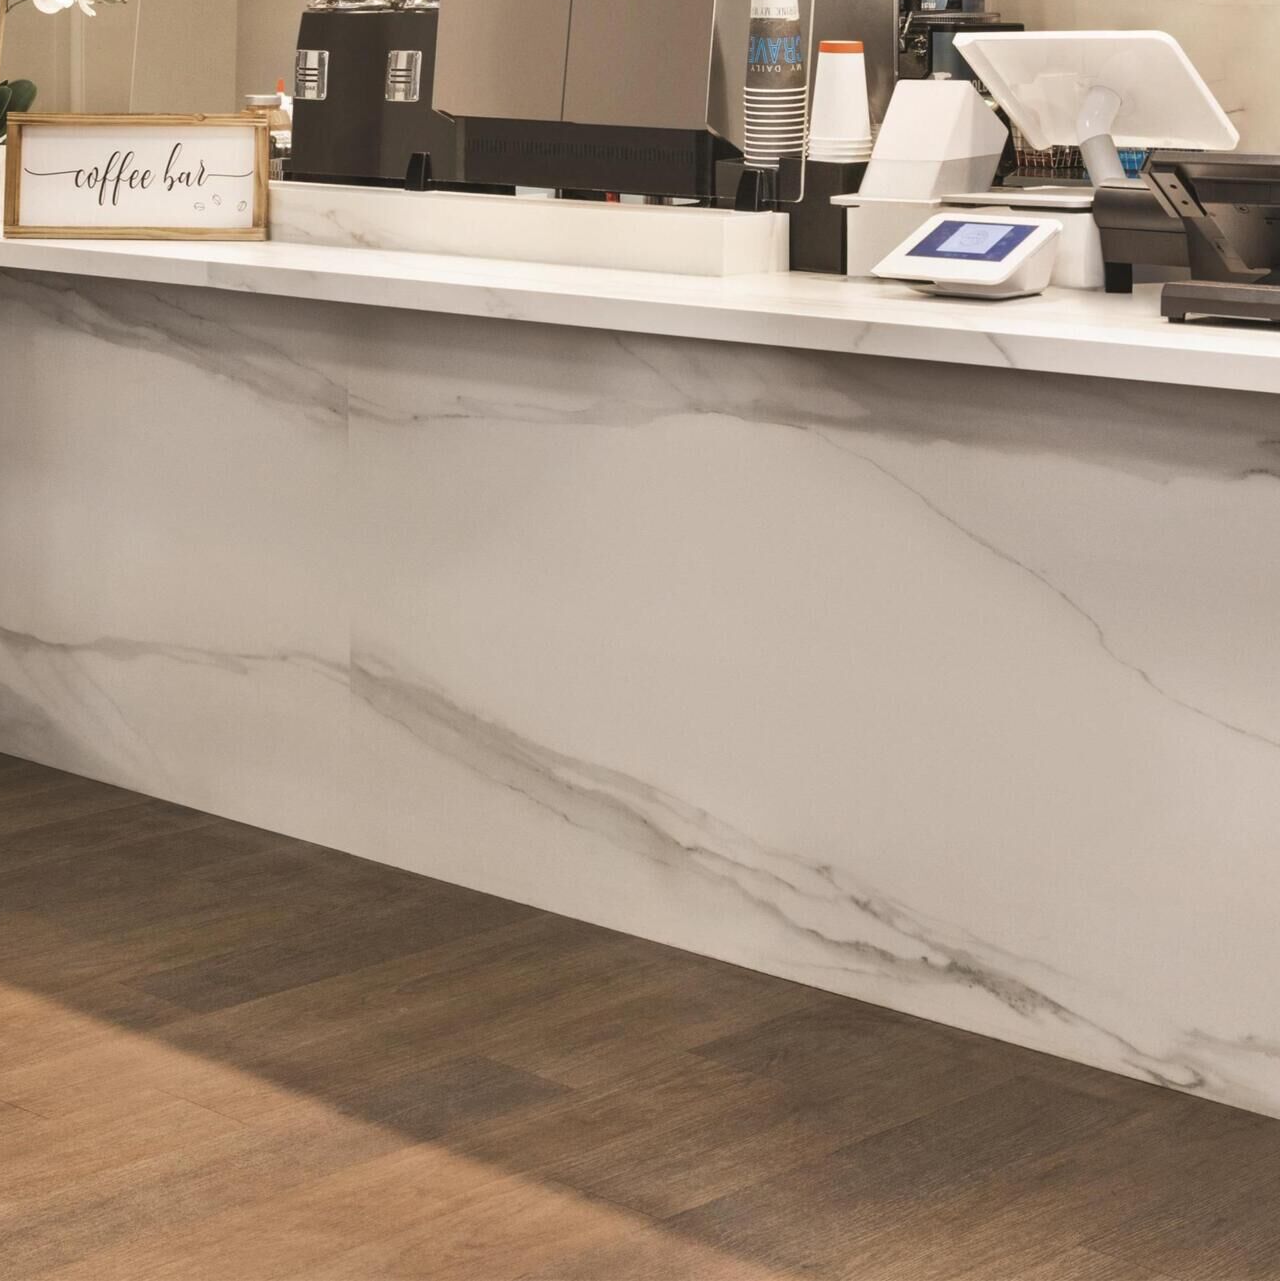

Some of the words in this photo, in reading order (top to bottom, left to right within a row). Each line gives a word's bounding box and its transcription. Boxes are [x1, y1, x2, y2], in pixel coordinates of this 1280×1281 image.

[751, 64, 781, 73] DAILY
[70, 151, 154, 206] coffee
[163, 142, 217, 192] bar
